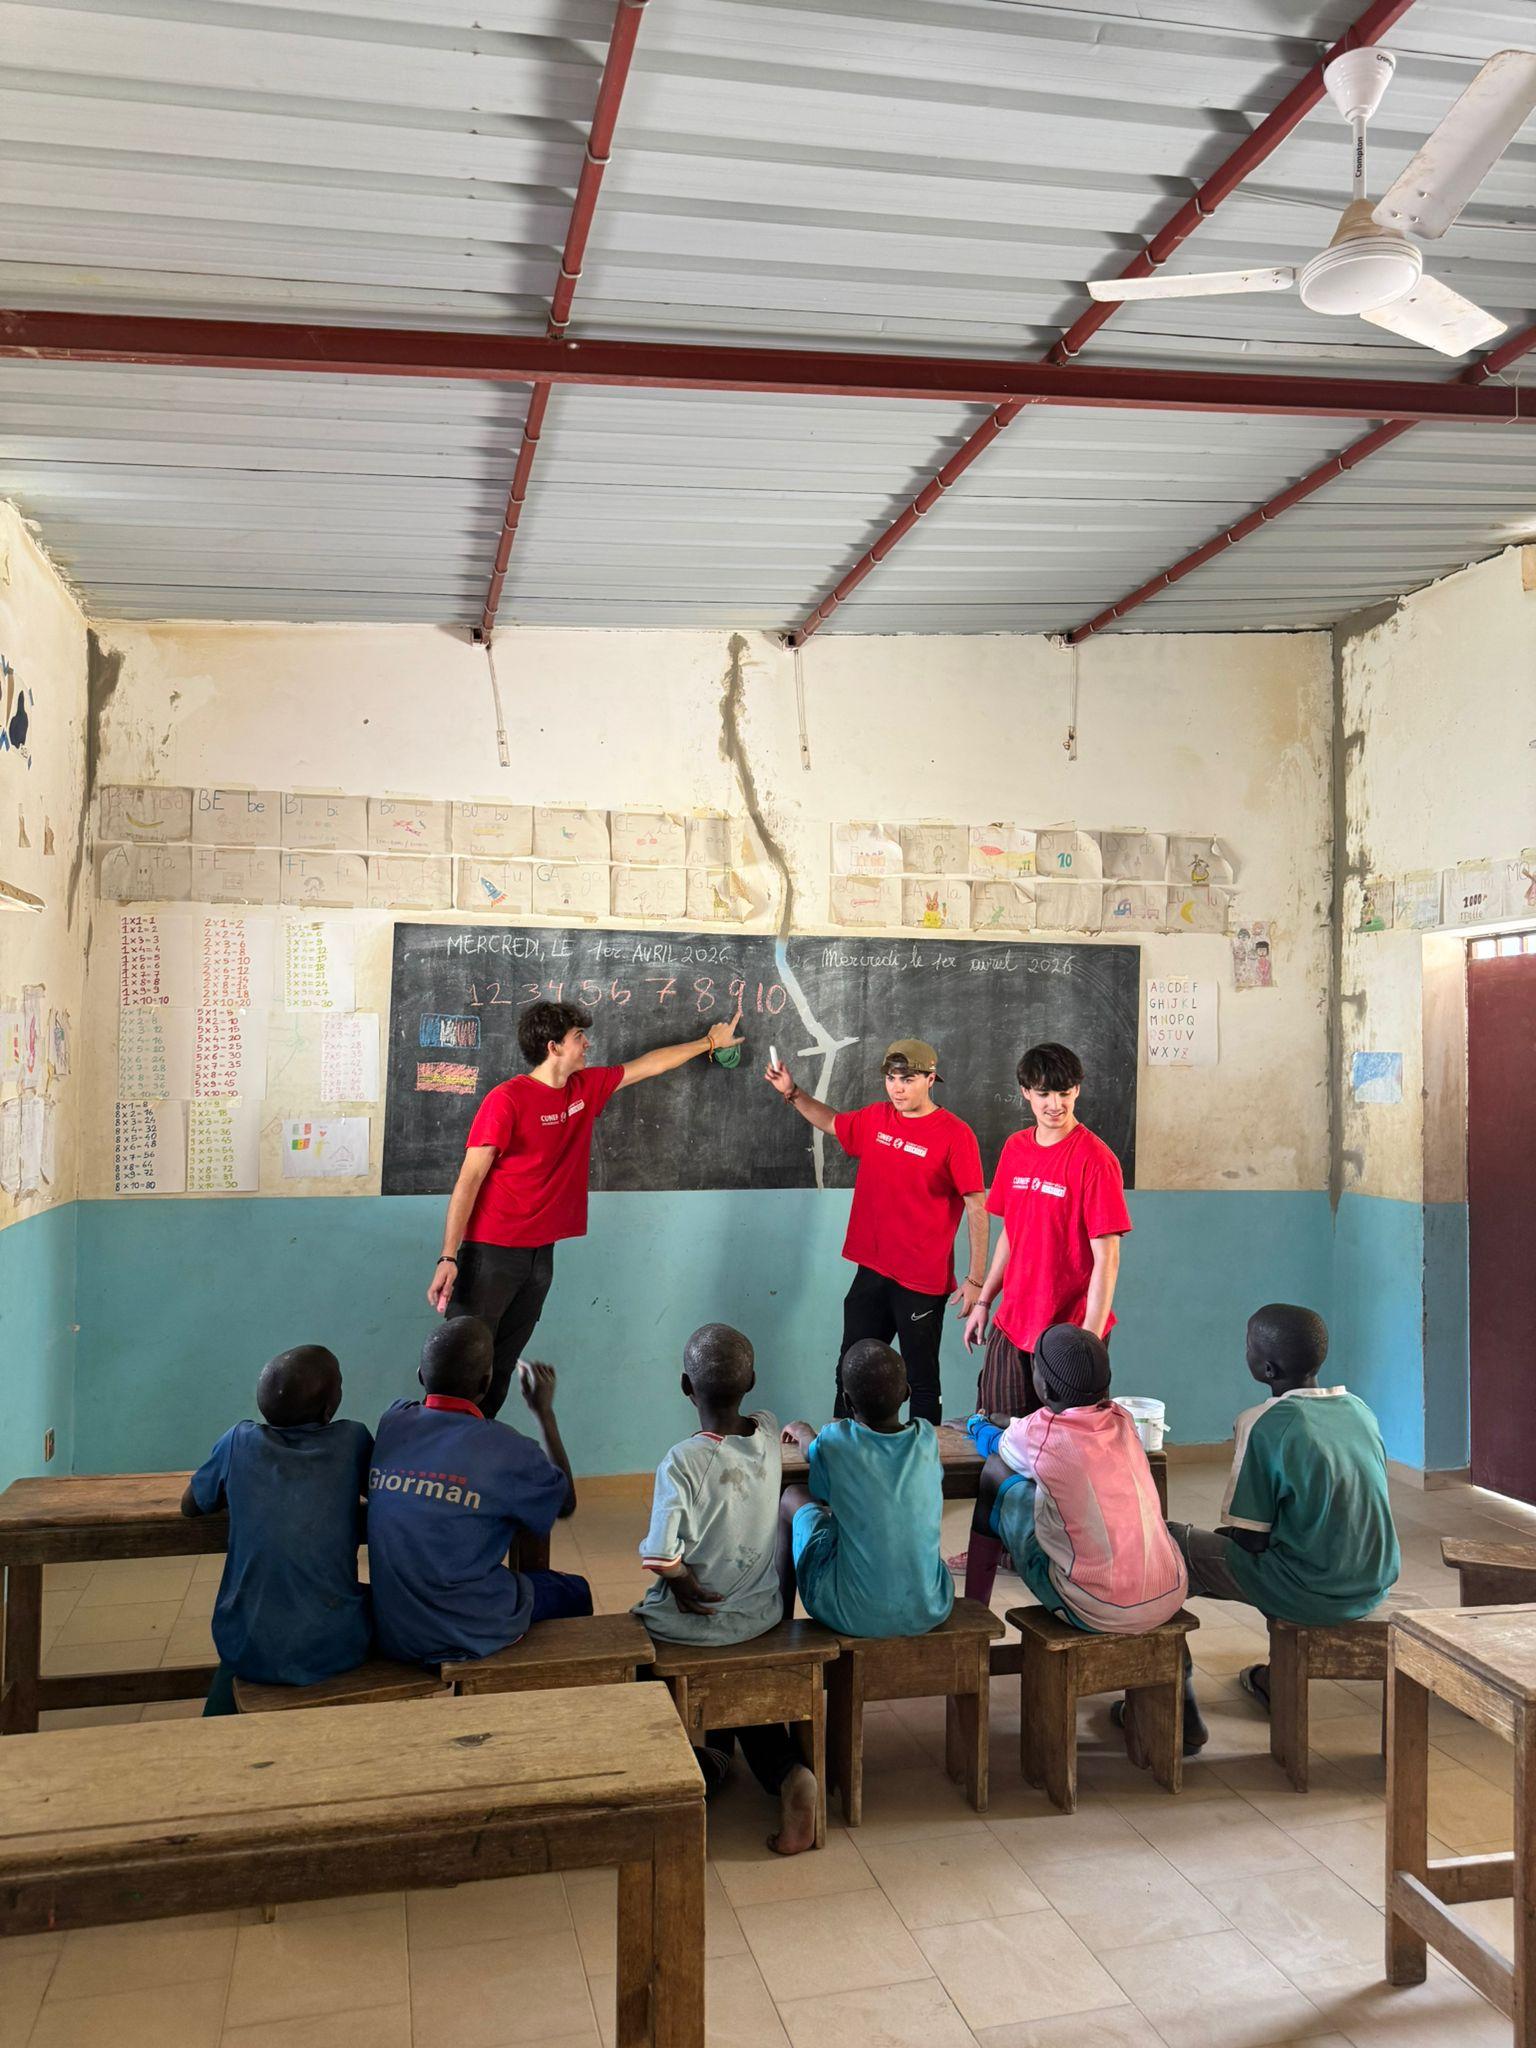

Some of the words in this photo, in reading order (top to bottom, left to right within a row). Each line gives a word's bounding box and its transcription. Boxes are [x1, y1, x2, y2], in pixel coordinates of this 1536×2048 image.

[1355, 136, 1364, 178] Crompton
[199, 789, 226, 811] BE
[247, 791, 265, 813] be
[1057, 852, 1073, 868] 10
[551, 939, 574, 957] LE
[632, 942, 679, 963] AVRIL
[910, 945, 924, 968] le
[1028, 954, 1076, 975] 2026
[469, 983, 484, 1006] 1
[486, 982, 512, 1005] 2
[517, 983, 543, 1005] 3
[548, 981, 564, 1003] 4
[579, 979, 603, 1006] 5
[611, 978, 632, 1006] 6
[644, 977, 677, 1004] 7
[693, 977, 716, 1012] 8
[729, 977, 746, 1014] 9
[756, 981, 788, 1014] 10
[368, 1467, 481, 1510] Giorman
